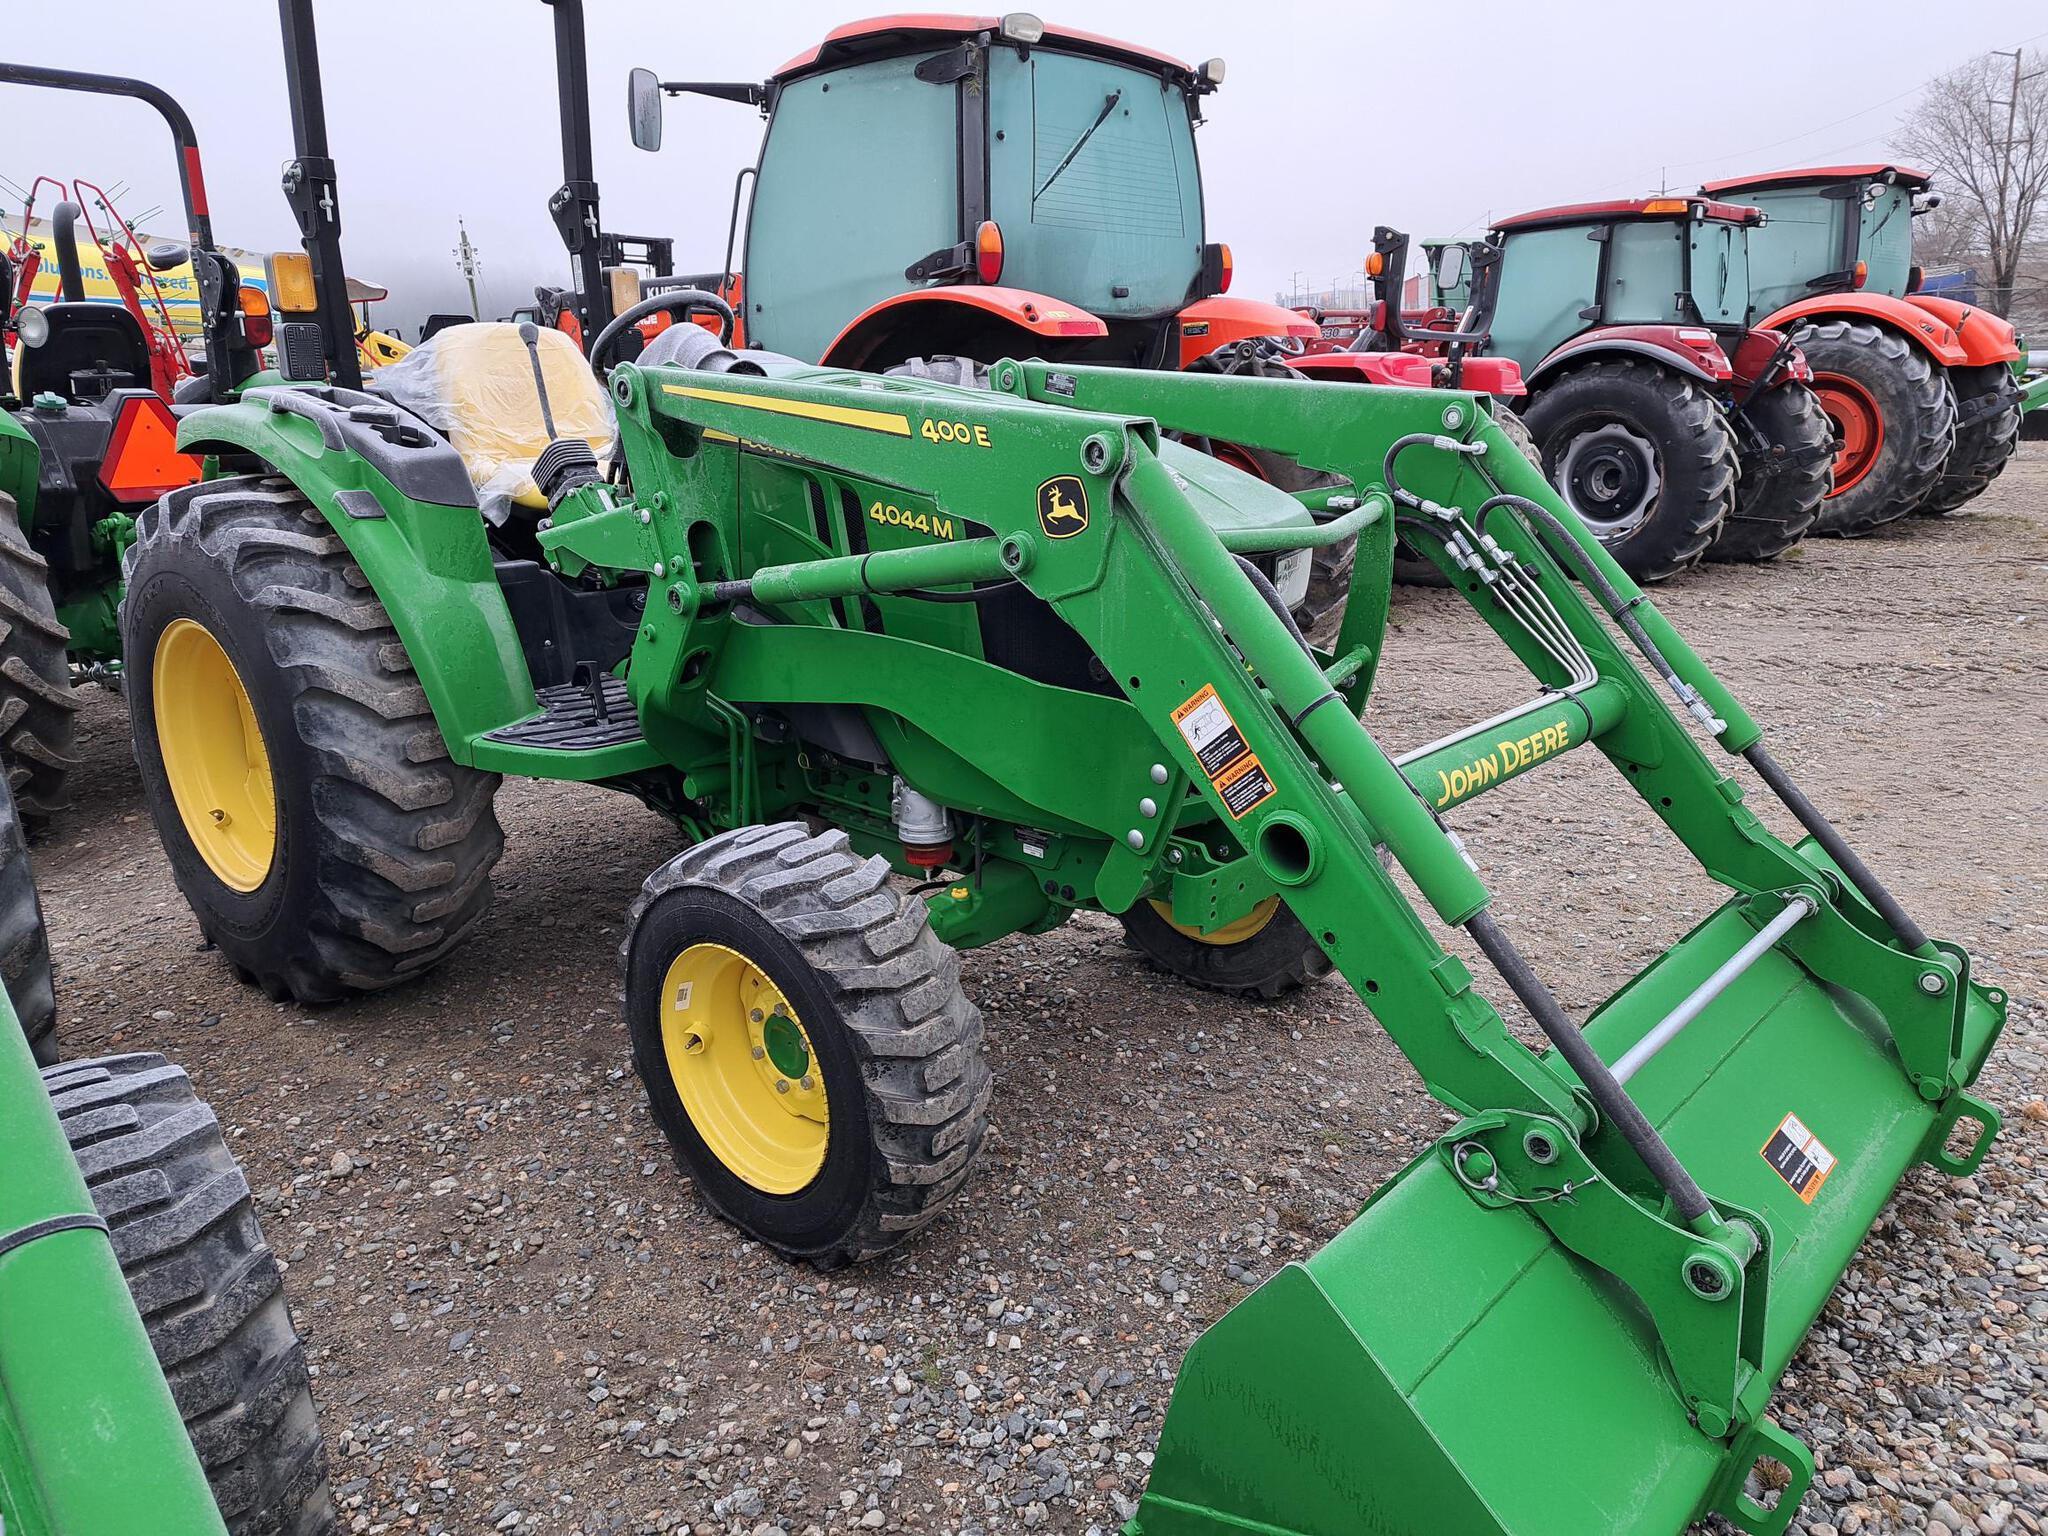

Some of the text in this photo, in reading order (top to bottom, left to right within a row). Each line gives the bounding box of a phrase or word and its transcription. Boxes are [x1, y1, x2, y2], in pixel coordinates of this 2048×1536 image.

[1182, 690, 1210, 713] WARNING
[1225, 760, 1254, 783] WARNING
[1437, 720, 1569, 807] JOHN DEERE
